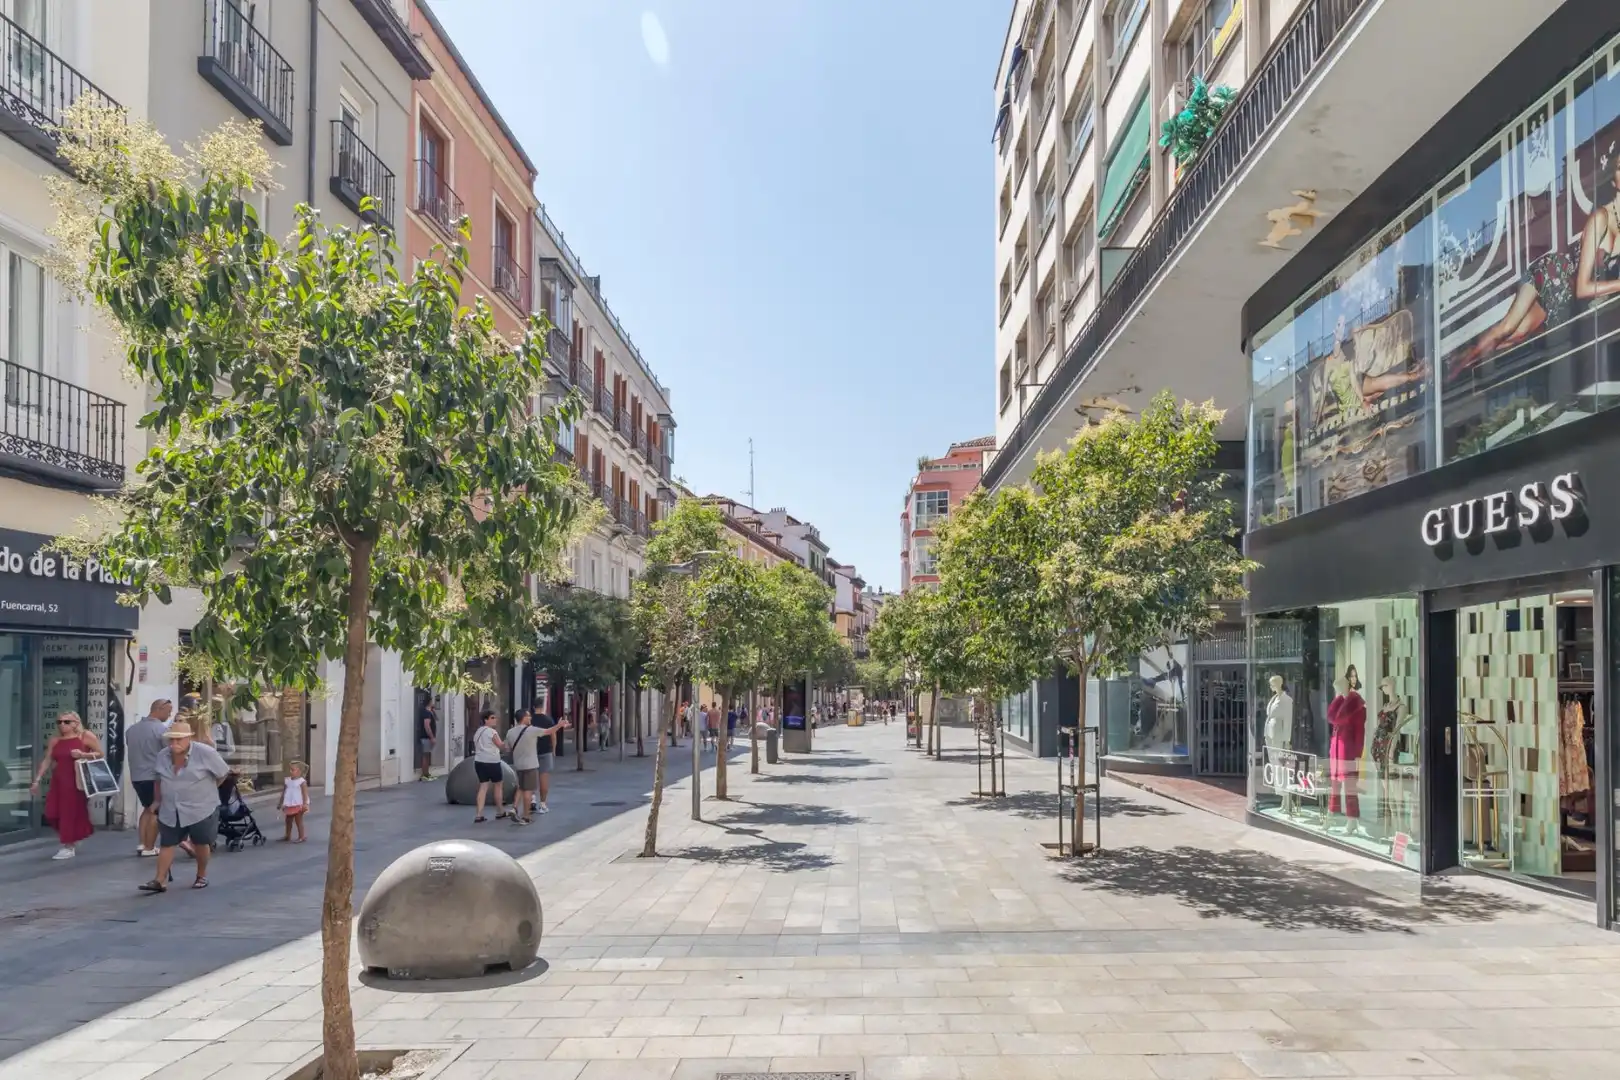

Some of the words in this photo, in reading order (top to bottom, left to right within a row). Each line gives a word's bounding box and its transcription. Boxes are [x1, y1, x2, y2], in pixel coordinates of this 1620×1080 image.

[1421, 472, 1578, 546] GUESS
[0, 546, 24, 574] do
[29, 550, 56, 578] de
[62, 554, 80, 580] la
[85, 557, 132, 586] Plaa
[0, 600, 47, 614] Fuencarral,
[48, 604, 59, 613] 52
[1264, 763, 1315, 796] GUESS
